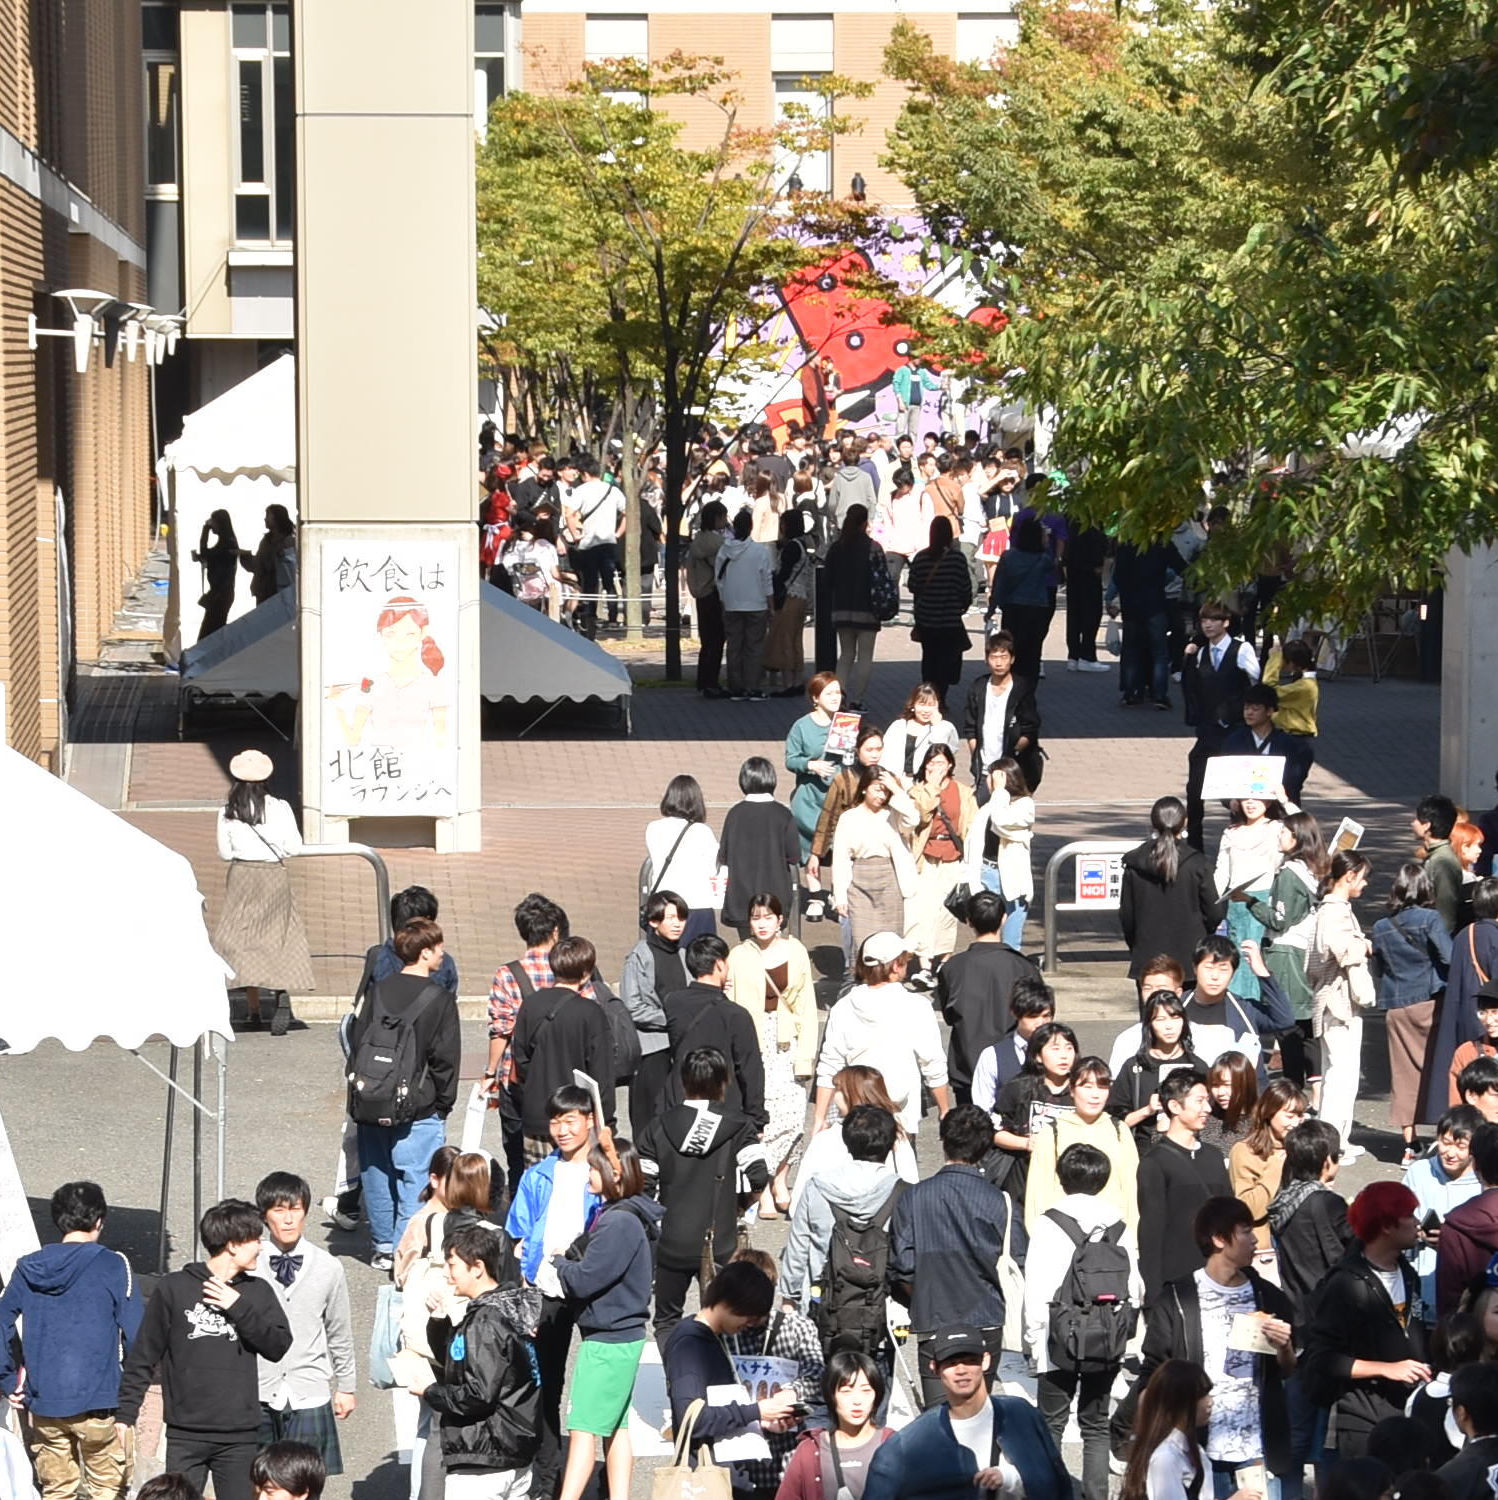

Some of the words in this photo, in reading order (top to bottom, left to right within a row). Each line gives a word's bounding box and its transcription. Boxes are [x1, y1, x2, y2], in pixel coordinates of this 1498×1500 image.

[333, 555, 445, 593] 飲食は
[329, 747, 402, 782] 北館
[350, 779, 452, 802] ラウンジへ
